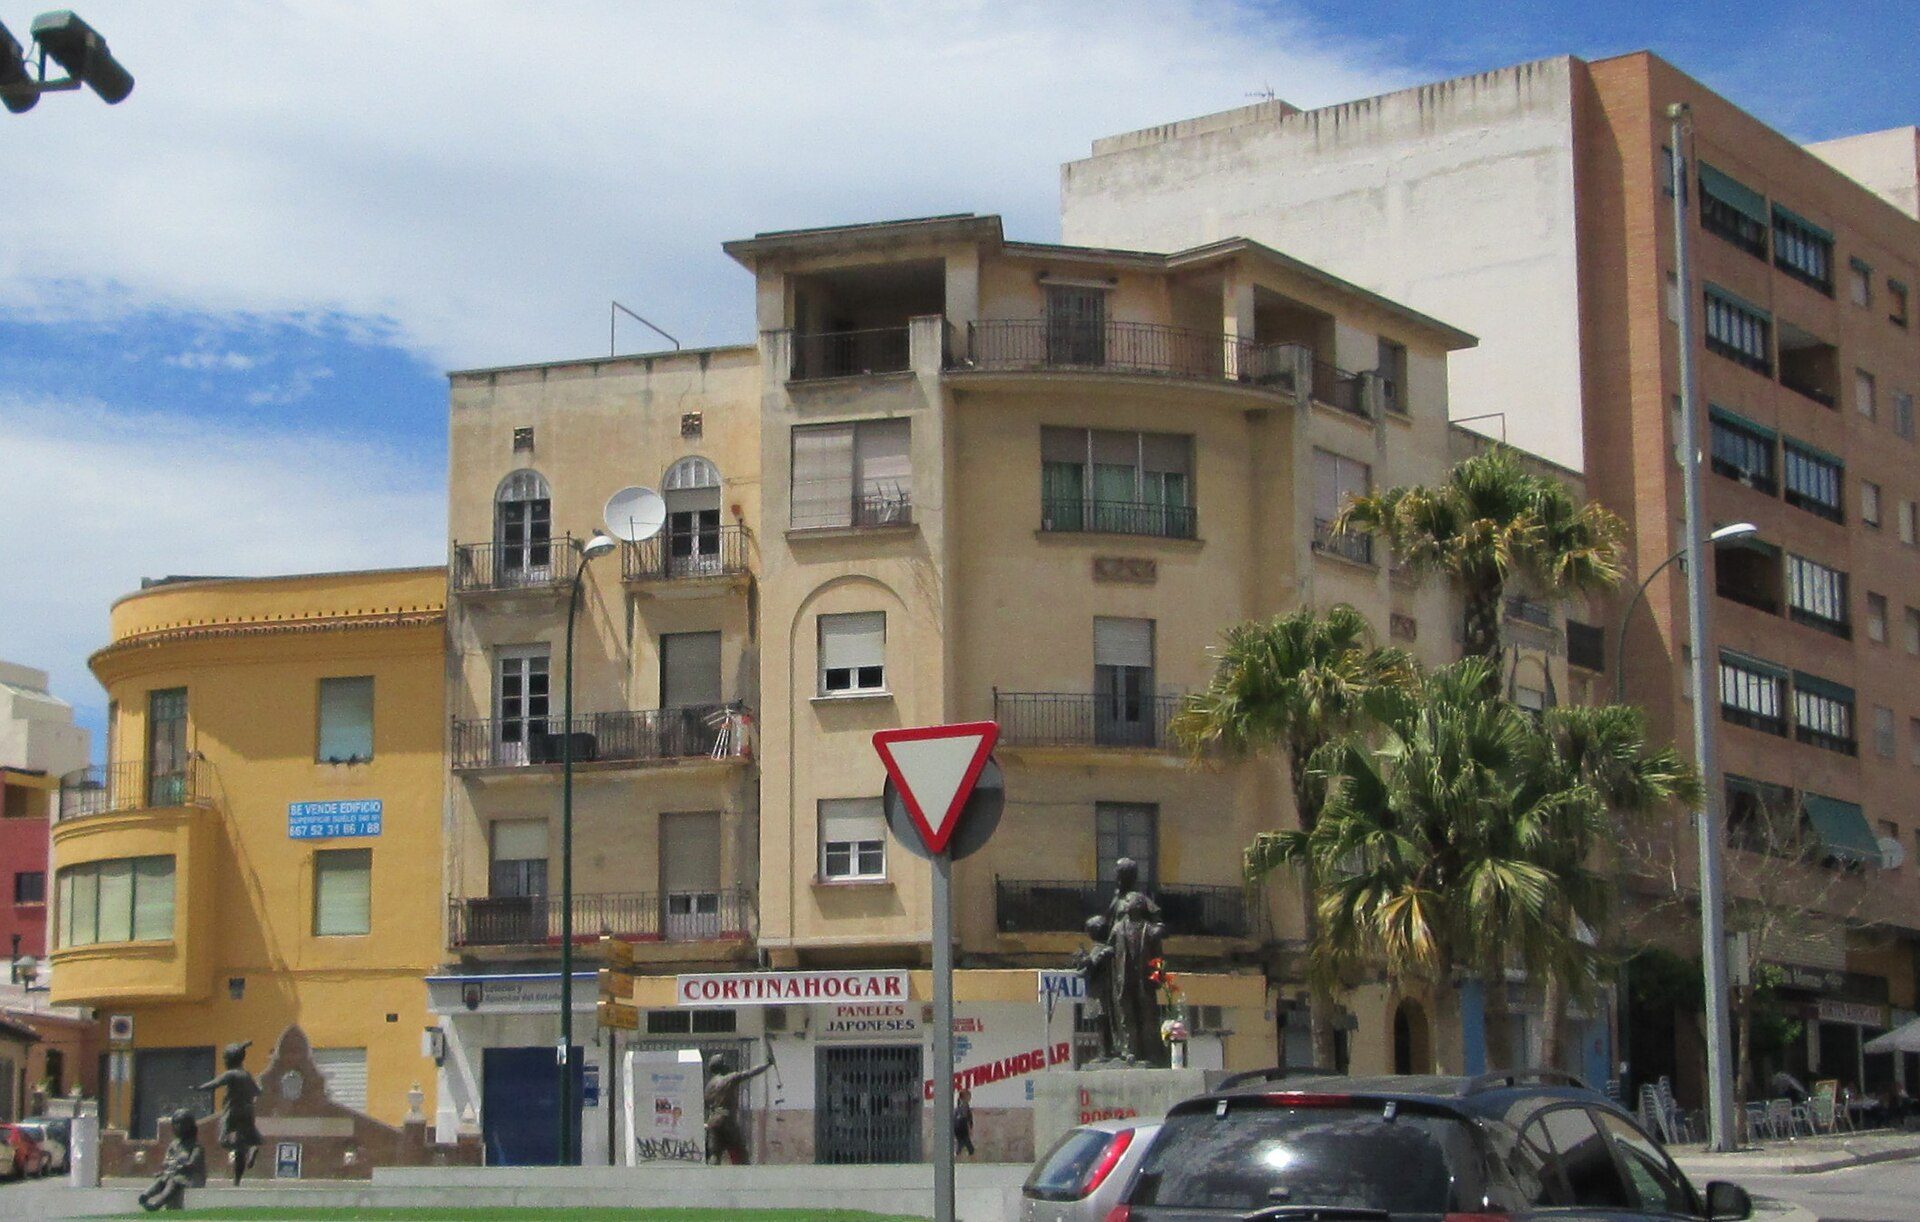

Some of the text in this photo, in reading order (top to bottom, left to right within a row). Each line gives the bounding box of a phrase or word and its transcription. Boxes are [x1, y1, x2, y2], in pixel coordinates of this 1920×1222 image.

[305, 803, 337, 814] VENDE
[340, 801, 381, 813] EDIFICIO
[683, 976, 902, 1000] CORTINAHOGAR
[836, 1004, 904, 1018] PANELES
[826, 1019, 916, 1032] JAPONESES
[924, 1042, 1070, 1100] CRTINAHOGAR
